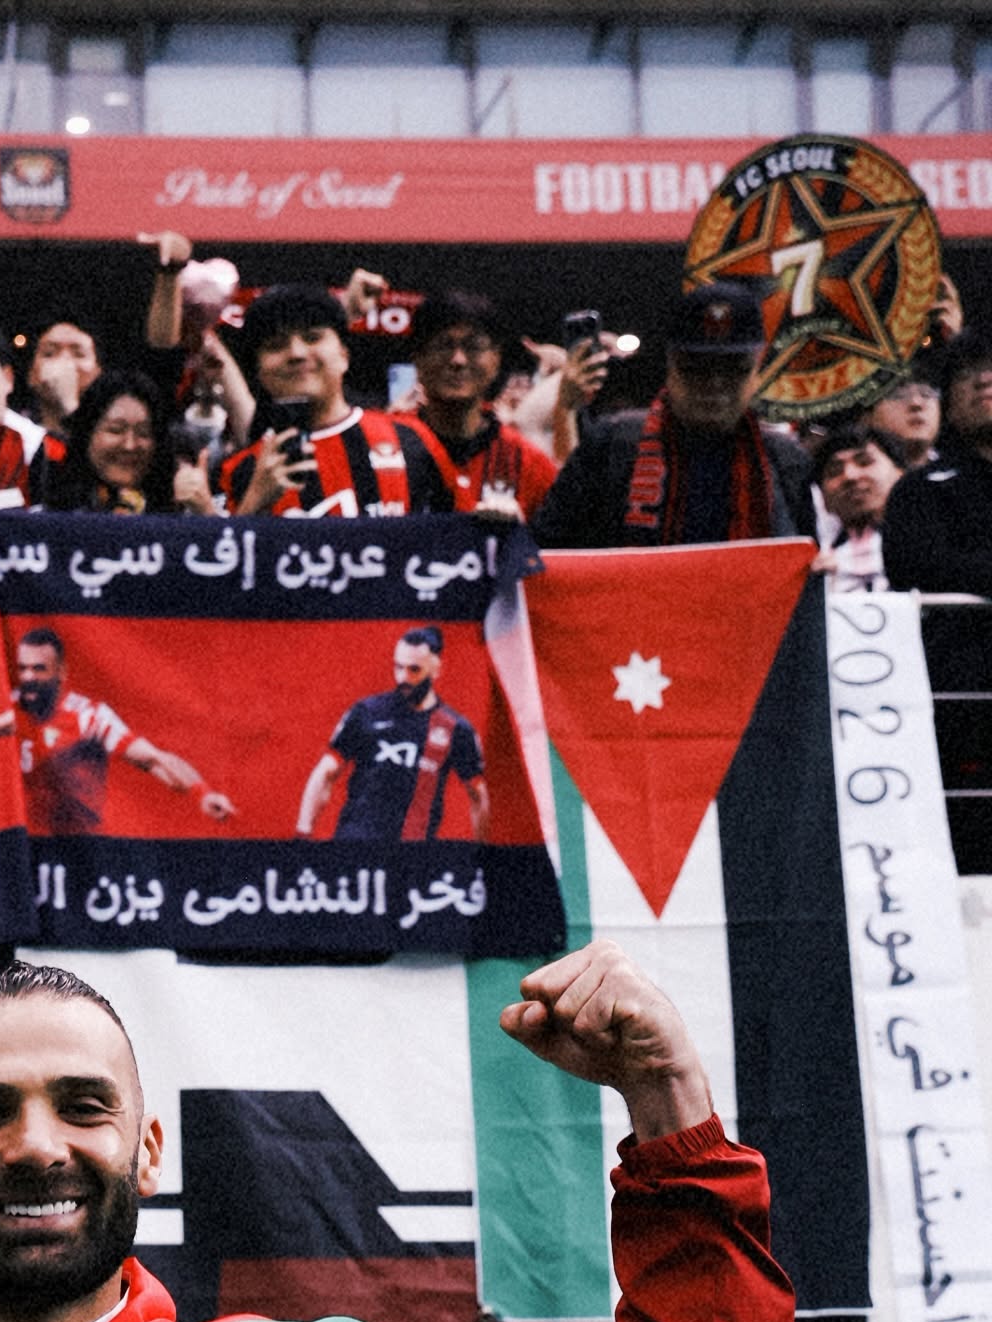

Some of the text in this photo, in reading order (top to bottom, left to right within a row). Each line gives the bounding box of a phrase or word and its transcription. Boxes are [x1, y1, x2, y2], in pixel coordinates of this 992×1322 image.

[765, 146, 837, 178] SEOUL
[256, 170, 308, 219] of
[771, 240, 824, 317] 7
[69, 542, 164, 598] سي
[276, 543, 386, 594] عرين
[831, 602, 912, 805] 2026
[85, 873, 164, 926] يزن
[399, 866, 487, 929] فخر
